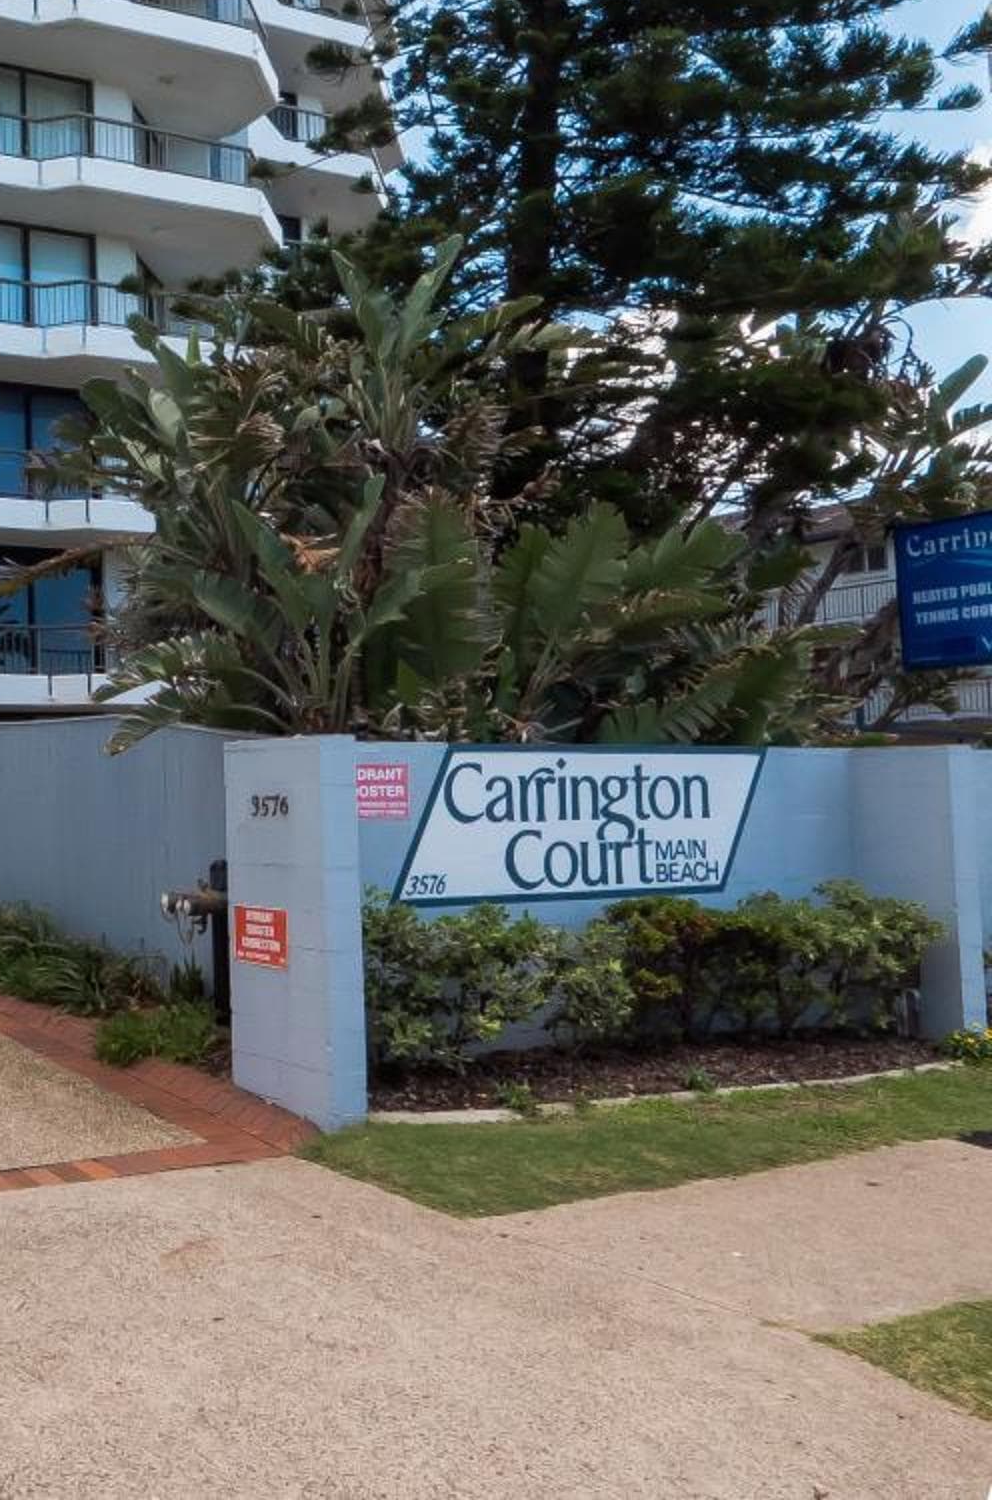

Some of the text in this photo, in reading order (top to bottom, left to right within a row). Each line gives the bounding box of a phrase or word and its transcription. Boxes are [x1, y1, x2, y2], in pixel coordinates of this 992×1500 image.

[907, 527, 992, 557] Carrin
[915, 607, 959, 624] TENNIS
[356, 785, 405, 798] OSTER
[444, 757, 711, 839] Carrington
[251, 794, 289, 817] 3576
[505, 827, 654, 889] Court
[655, 839, 707, 860] MAIN
[655, 860, 719, 882] BEACH
[405, 873, 446, 896] 3576
